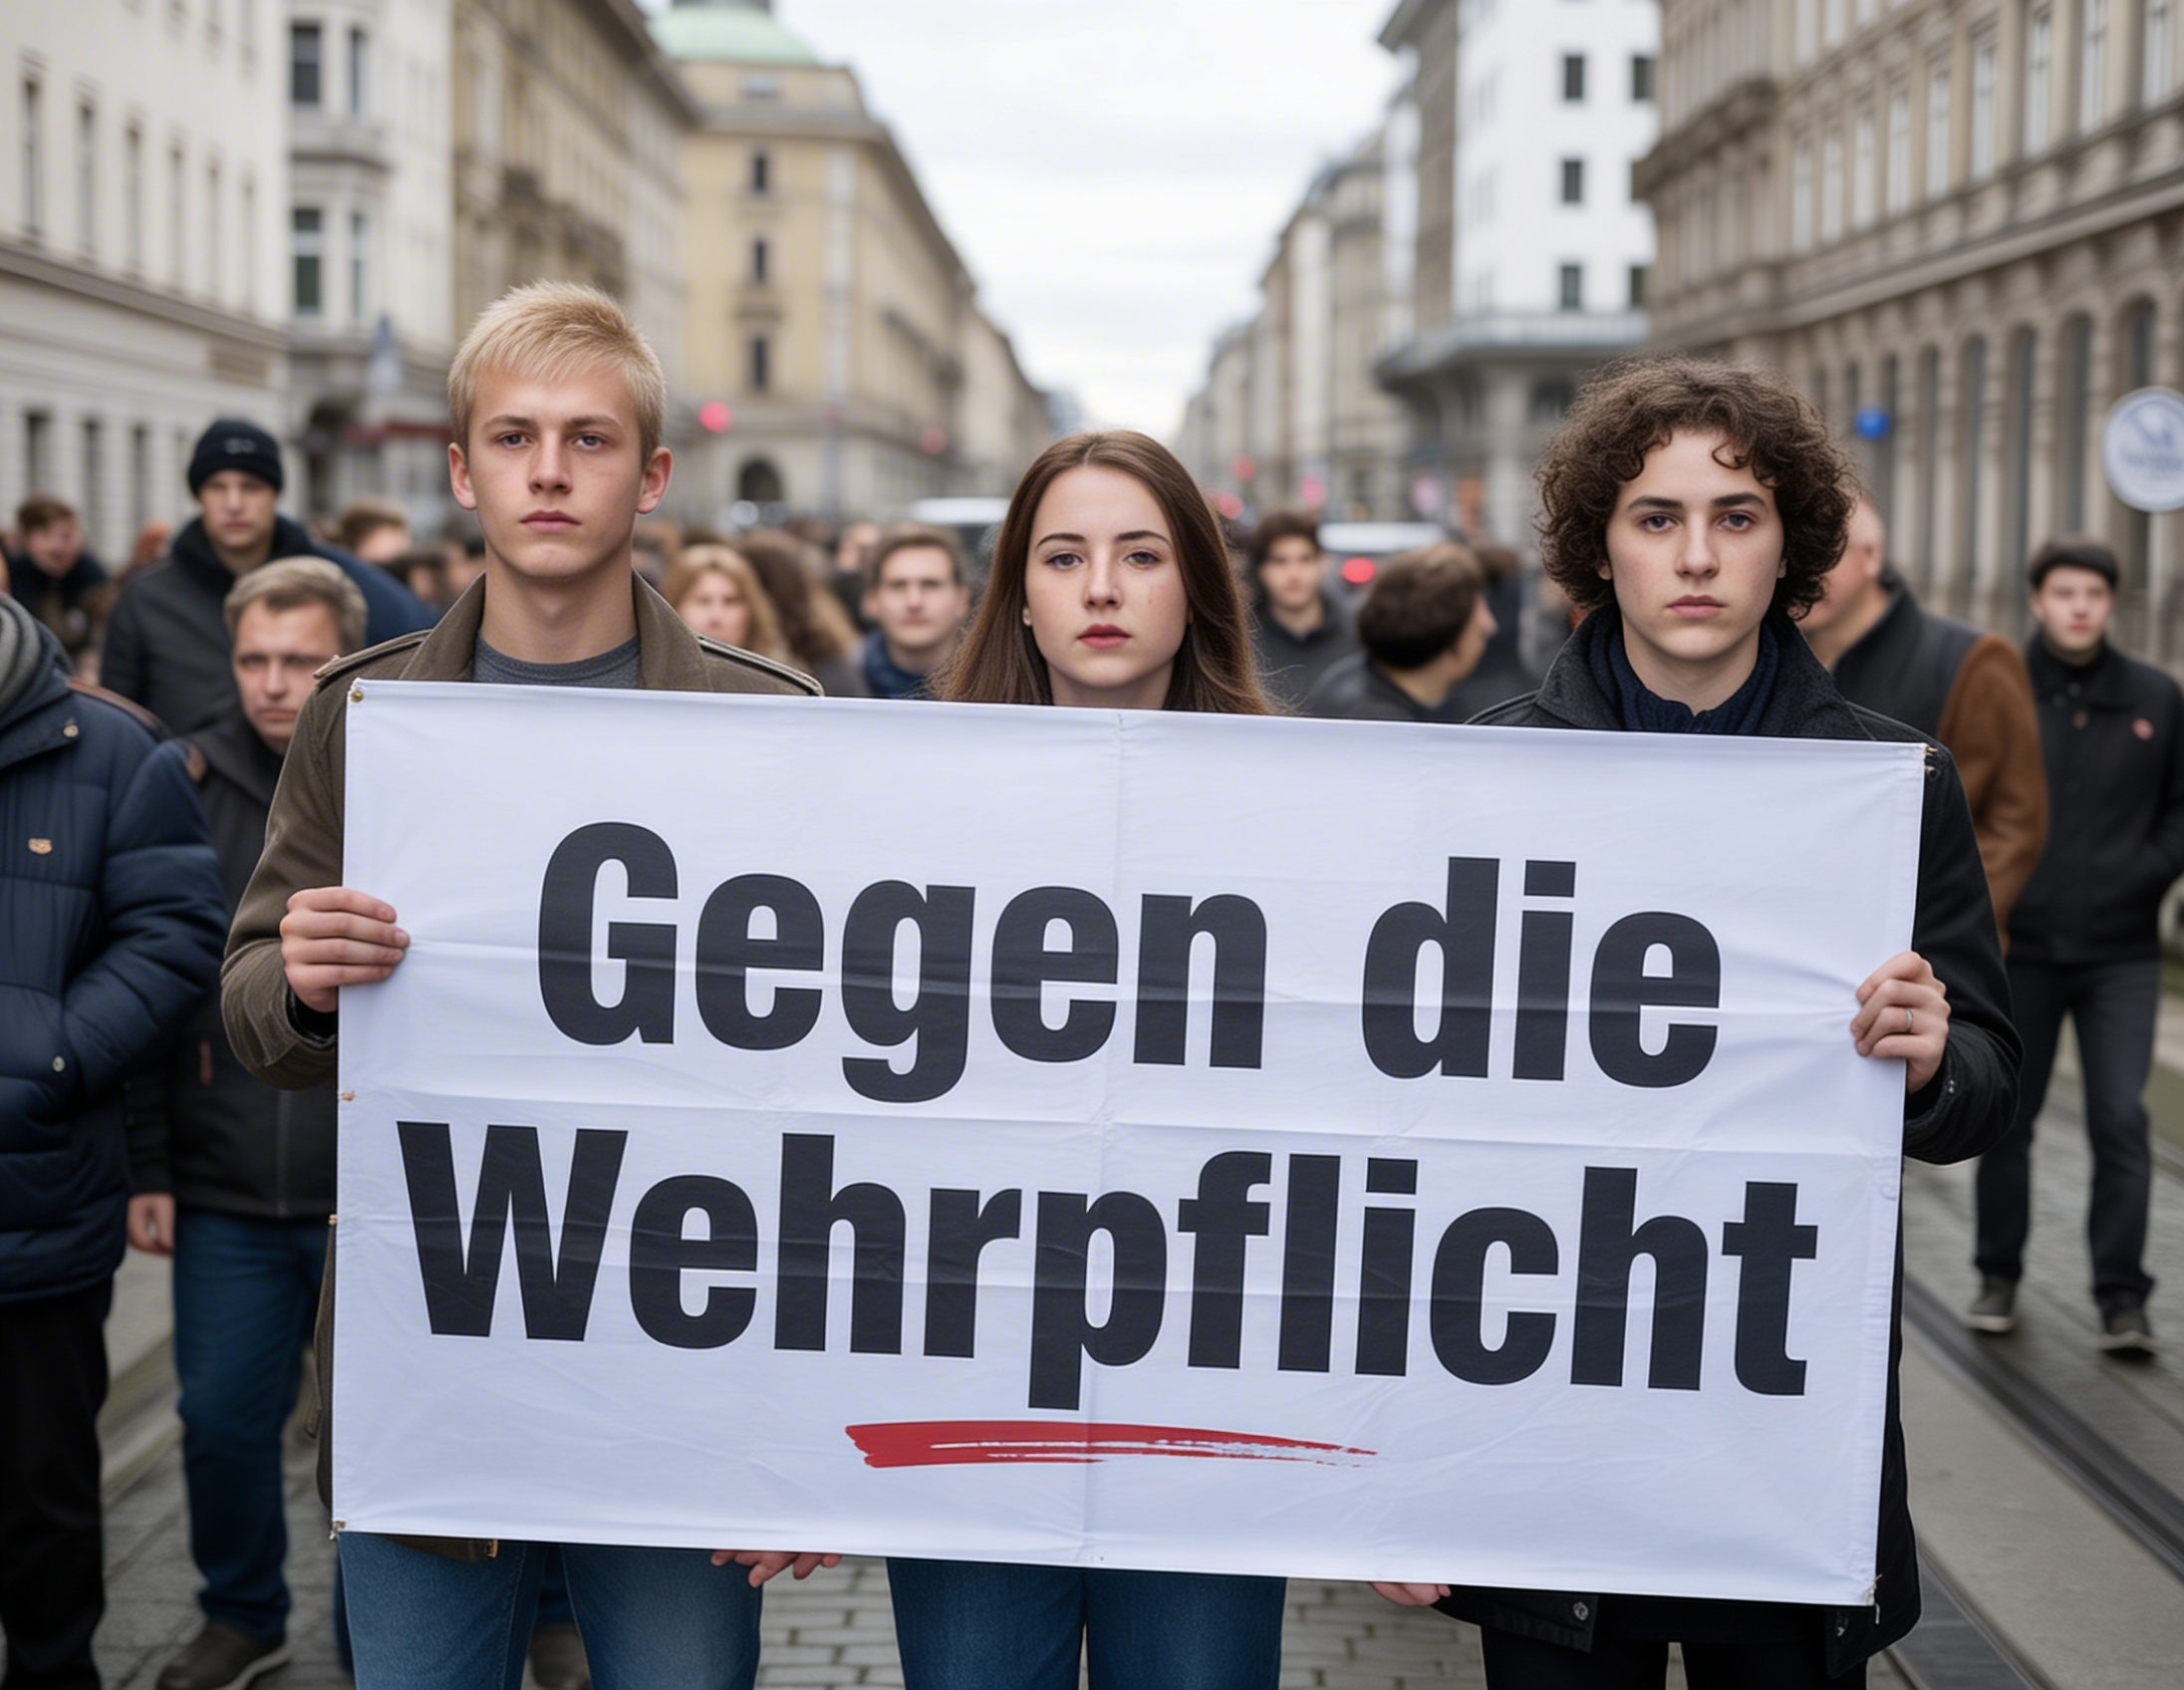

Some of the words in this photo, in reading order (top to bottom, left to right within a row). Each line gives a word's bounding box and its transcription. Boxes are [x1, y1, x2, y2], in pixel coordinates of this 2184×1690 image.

[538, 821, 1268, 1103] Gegen
[1361, 856, 1721, 1088] die
[396, 1120, 1818, 1411] Wehrpflicht
